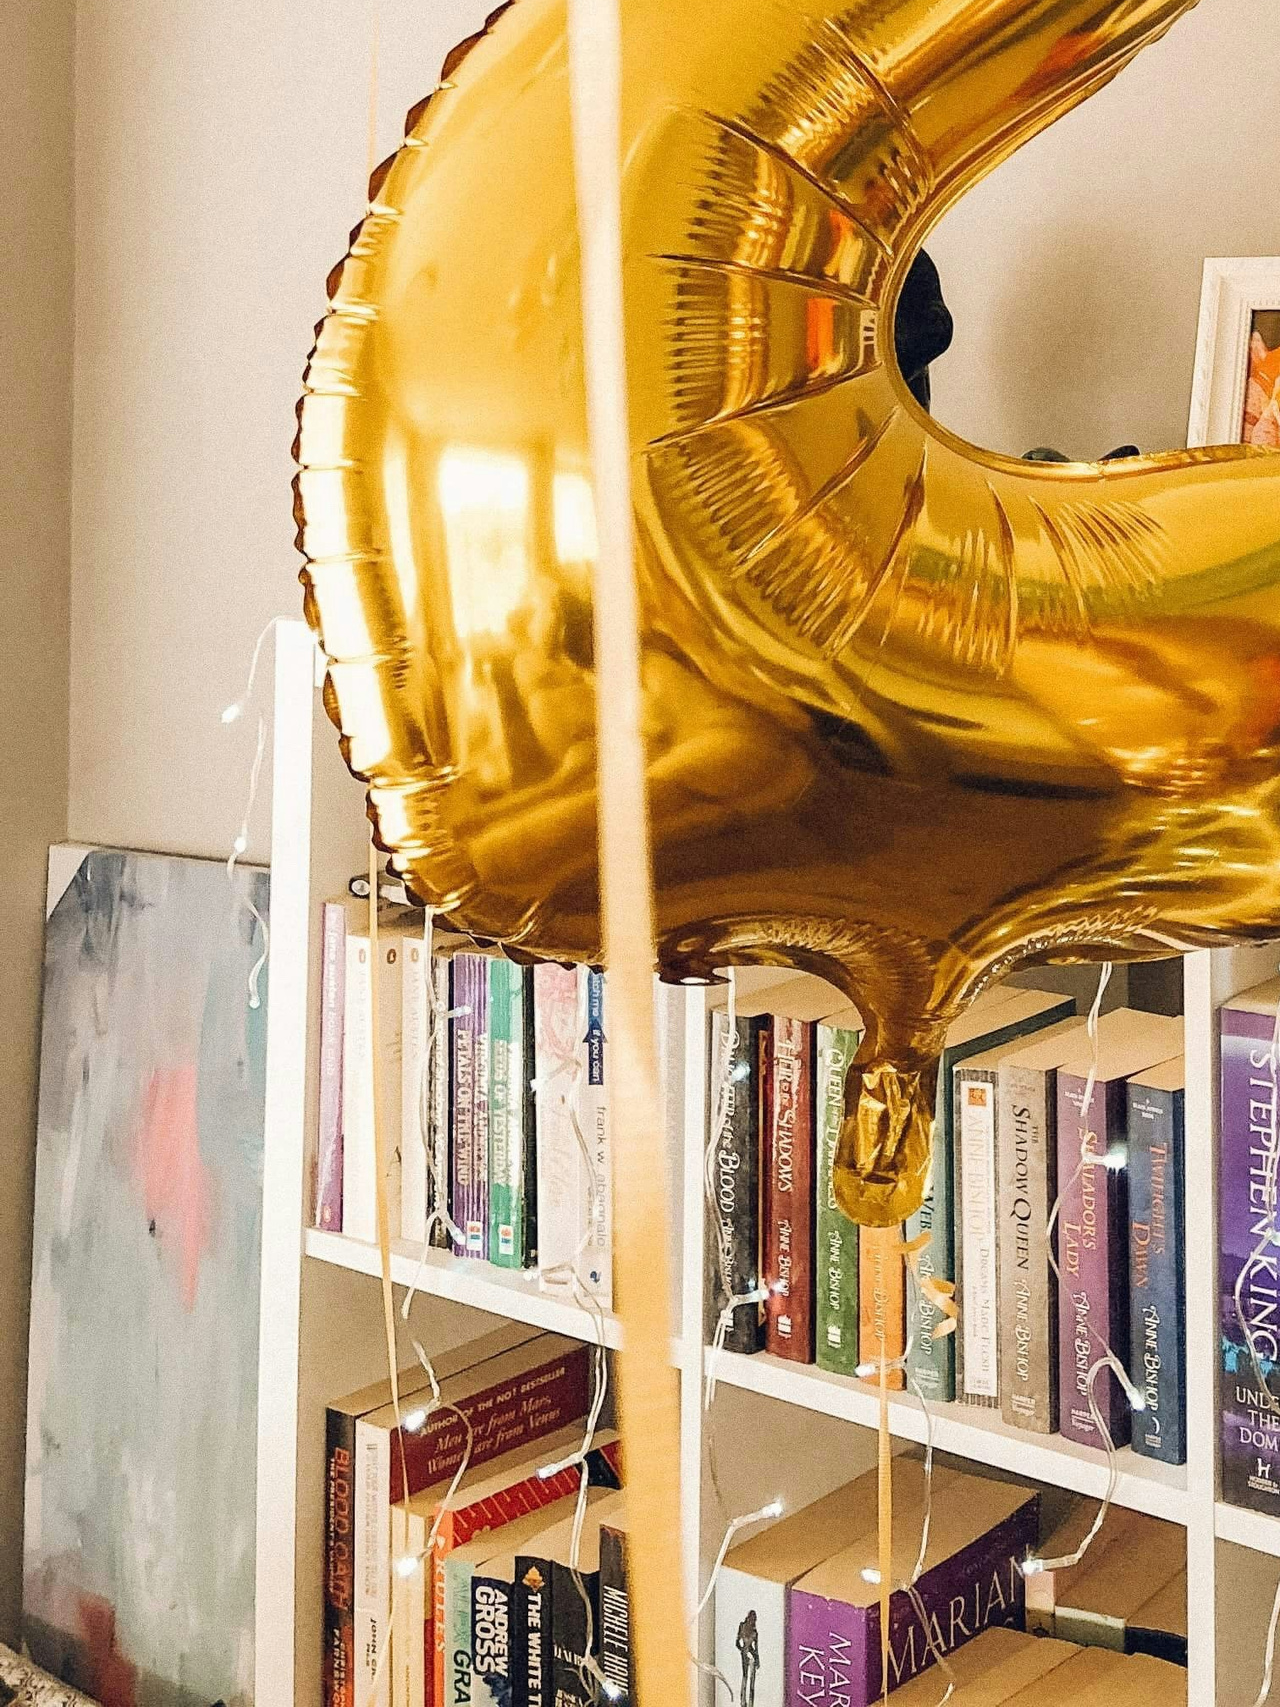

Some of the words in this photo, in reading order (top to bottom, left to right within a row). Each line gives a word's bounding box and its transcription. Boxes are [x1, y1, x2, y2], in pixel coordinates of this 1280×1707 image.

[457, 1029, 471, 1083] PETALS
[589, 1038, 600, 1058] you
[591, 1060, 600, 1082] can
[826, 1048, 844, 1106] QUEEN
[596, 1106, 607, 1144] frank
[777, 1109, 796, 1192] SHADOWS
[1011, 1105, 1031, 1194] SHADOW
[1248, 1048, 1278, 1236] STEPHEN
[457, 1145, 471, 1185] WIND
[719, 1150, 740, 1212] BLOOD
[778, 1220, 791, 1252] ANNE
[828, 1230, 842, 1263] ANNE
[1010, 1198, 1032, 1270] QUEEN
[1062, 1221, 1081, 1279] LADY
[1132, 1220, 1151, 1289] DAWN
[778, 1254, 791, 1297] BISHOP
[828, 1266, 843, 1310] BISHOP
[1014, 1279, 1031, 1322] ANNE
[919, 1300, 935, 1355] BISHOP
[1073, 1292, 1089, 1336] ANNE
[1142, 1305, 1160, 1350] ANNE
[1247, 1251, 1279, 1362] KING
[1014, 1325, 1032, 1382] BISHOP
[1073, 1338, 1091, 1396] BISHOP
[420, 1413, 458, 1437] AUTHOR
[478, 1399, 494, 1413] THE
[520, 1367, 566, 1394] BESTSELLER
[1143, 1354, 1161, 1411] BISHOP
[427, 1450, 465, 1475] Wome
[493, 1424, 524, 1451] from
[529, 1407, 562, 1430] Venus
[486, 1411, 516, 1436] from
[1247, 1409, 1280, 1432] THE
[334, 1447, 351, 1534] BLOOD
[332, 1541, 351, 1612] OATH
[370, 1617, 378, 1654] JOHN
[475, 1585, 495, 1674] GROSS
[494, 1588, 509, 1678] ANDREW
[527, 1592, 542, 1628] THE
[603, 1585, 629, 1652] MICHELE
[333, 1628, 341, 1707] FARNSWO
[527, 1632, 542, 1689] WHITE
